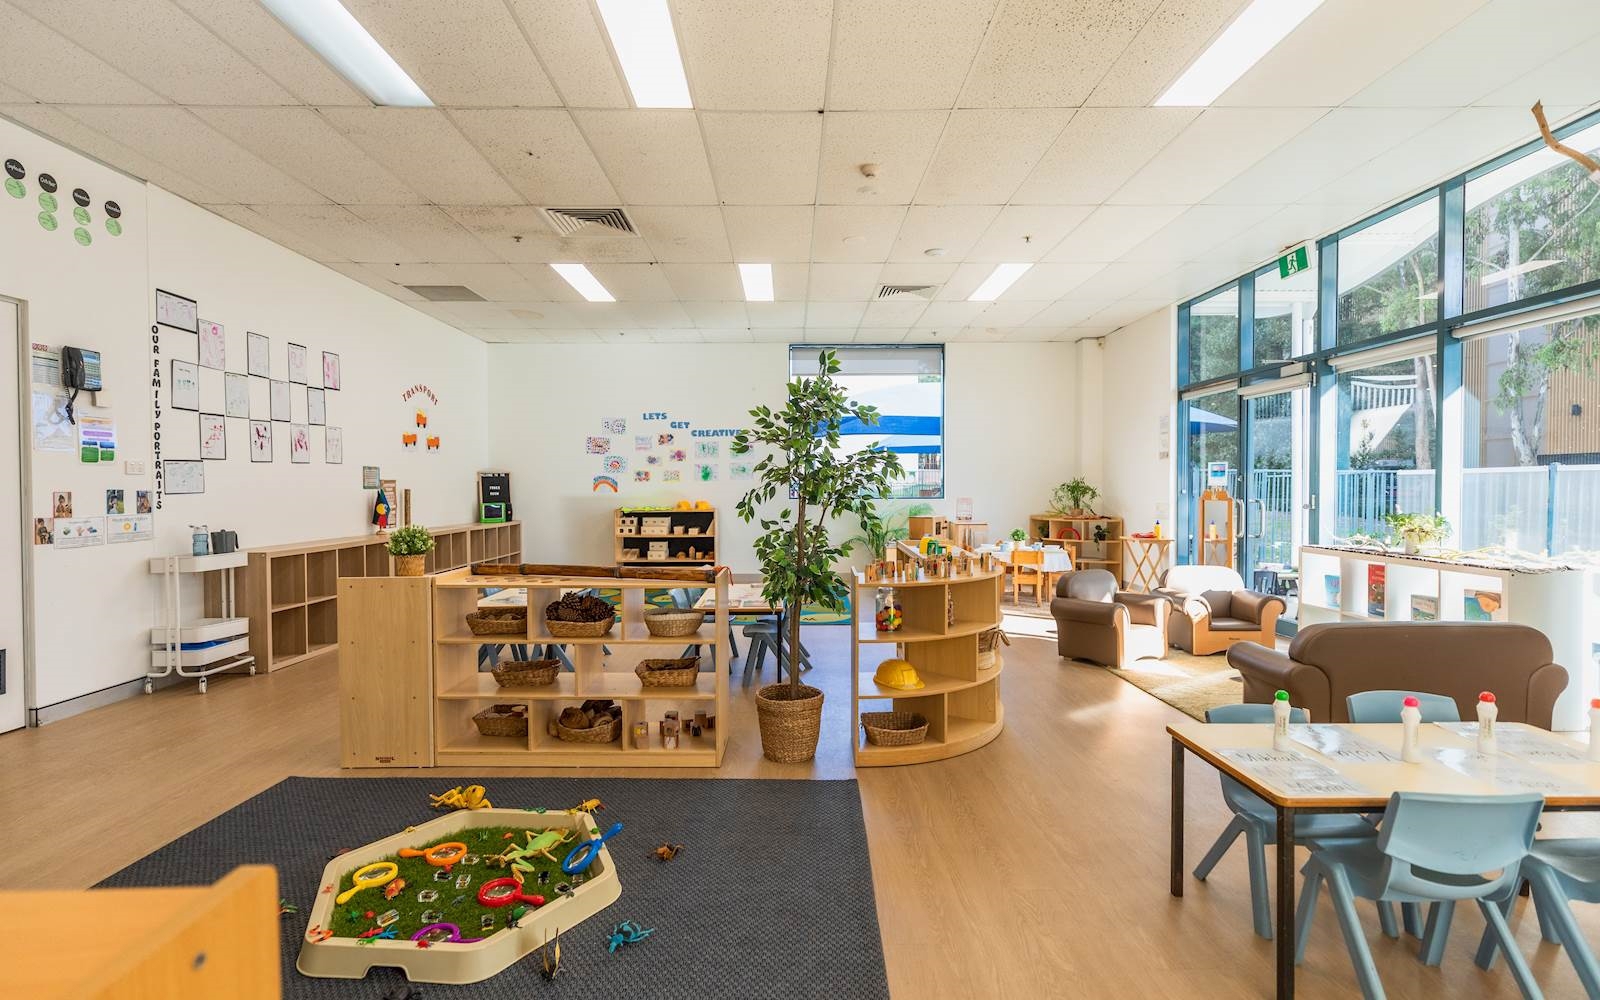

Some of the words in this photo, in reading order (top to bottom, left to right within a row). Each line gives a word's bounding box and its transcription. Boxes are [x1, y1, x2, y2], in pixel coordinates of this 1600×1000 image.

[152, 359, 161, 419] FAMILY
[402, 384, 438, 405] TRANSPORT
[643, 412, 667, 420] LETS
[670, 421, 690, 429] GET
[154, 422, 162, 510] PORTRAITS
